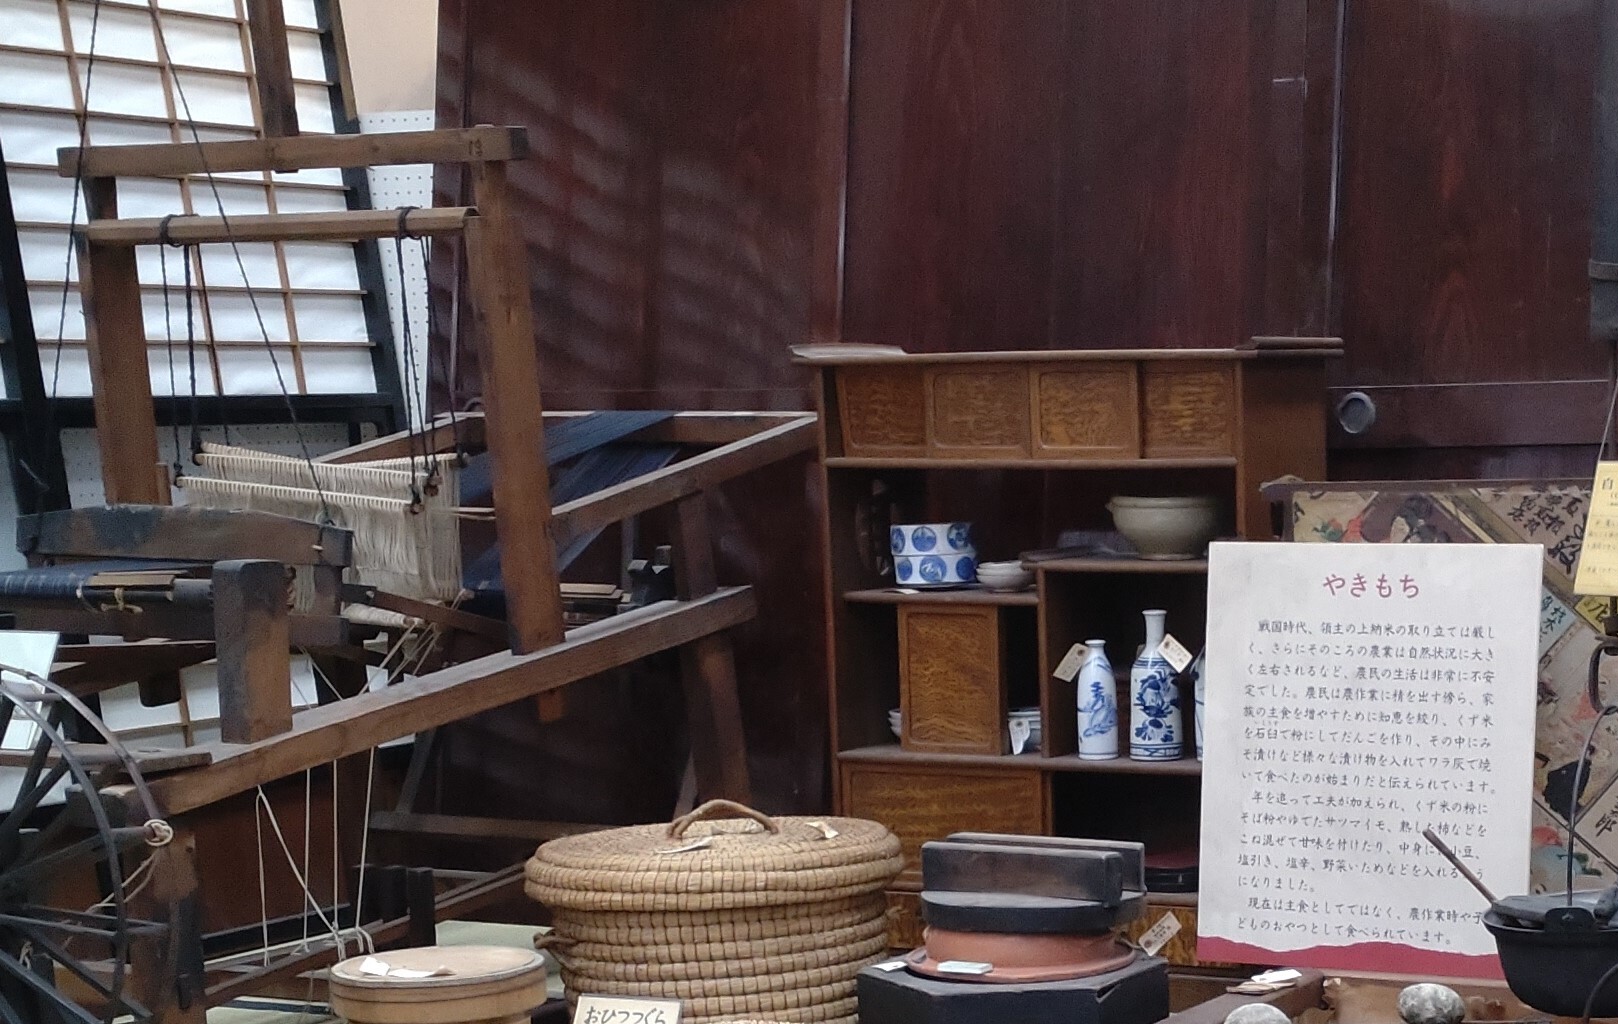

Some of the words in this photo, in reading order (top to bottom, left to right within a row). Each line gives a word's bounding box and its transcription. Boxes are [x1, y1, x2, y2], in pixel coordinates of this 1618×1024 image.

[1322, 572, 1421, 599] やきもち
[1257, 619, 1496, 639] 戦国時代、領主の上納米の取り立ては厳し
[1247, 642, 1495, 662] く、さらにそのころの農業は自然状況に大き
[1246, 664, 1496, 684] く左右されるなど、農民の生活は非常に不安
[1241, 769, 1496, 795] いて食べたのが始まりだと伝えられています。
[1251, 790, 1489, 815] 年を追って工夫が加えられ、くず米の粉に
[1237, 854, 1485, 881] 塩引き、塩辛、野菜いためなどを入れるう
[1237, 876, 1316, 893] になりました。
[1237, 917, 1453, 945] どものおやつとして食べられています。
